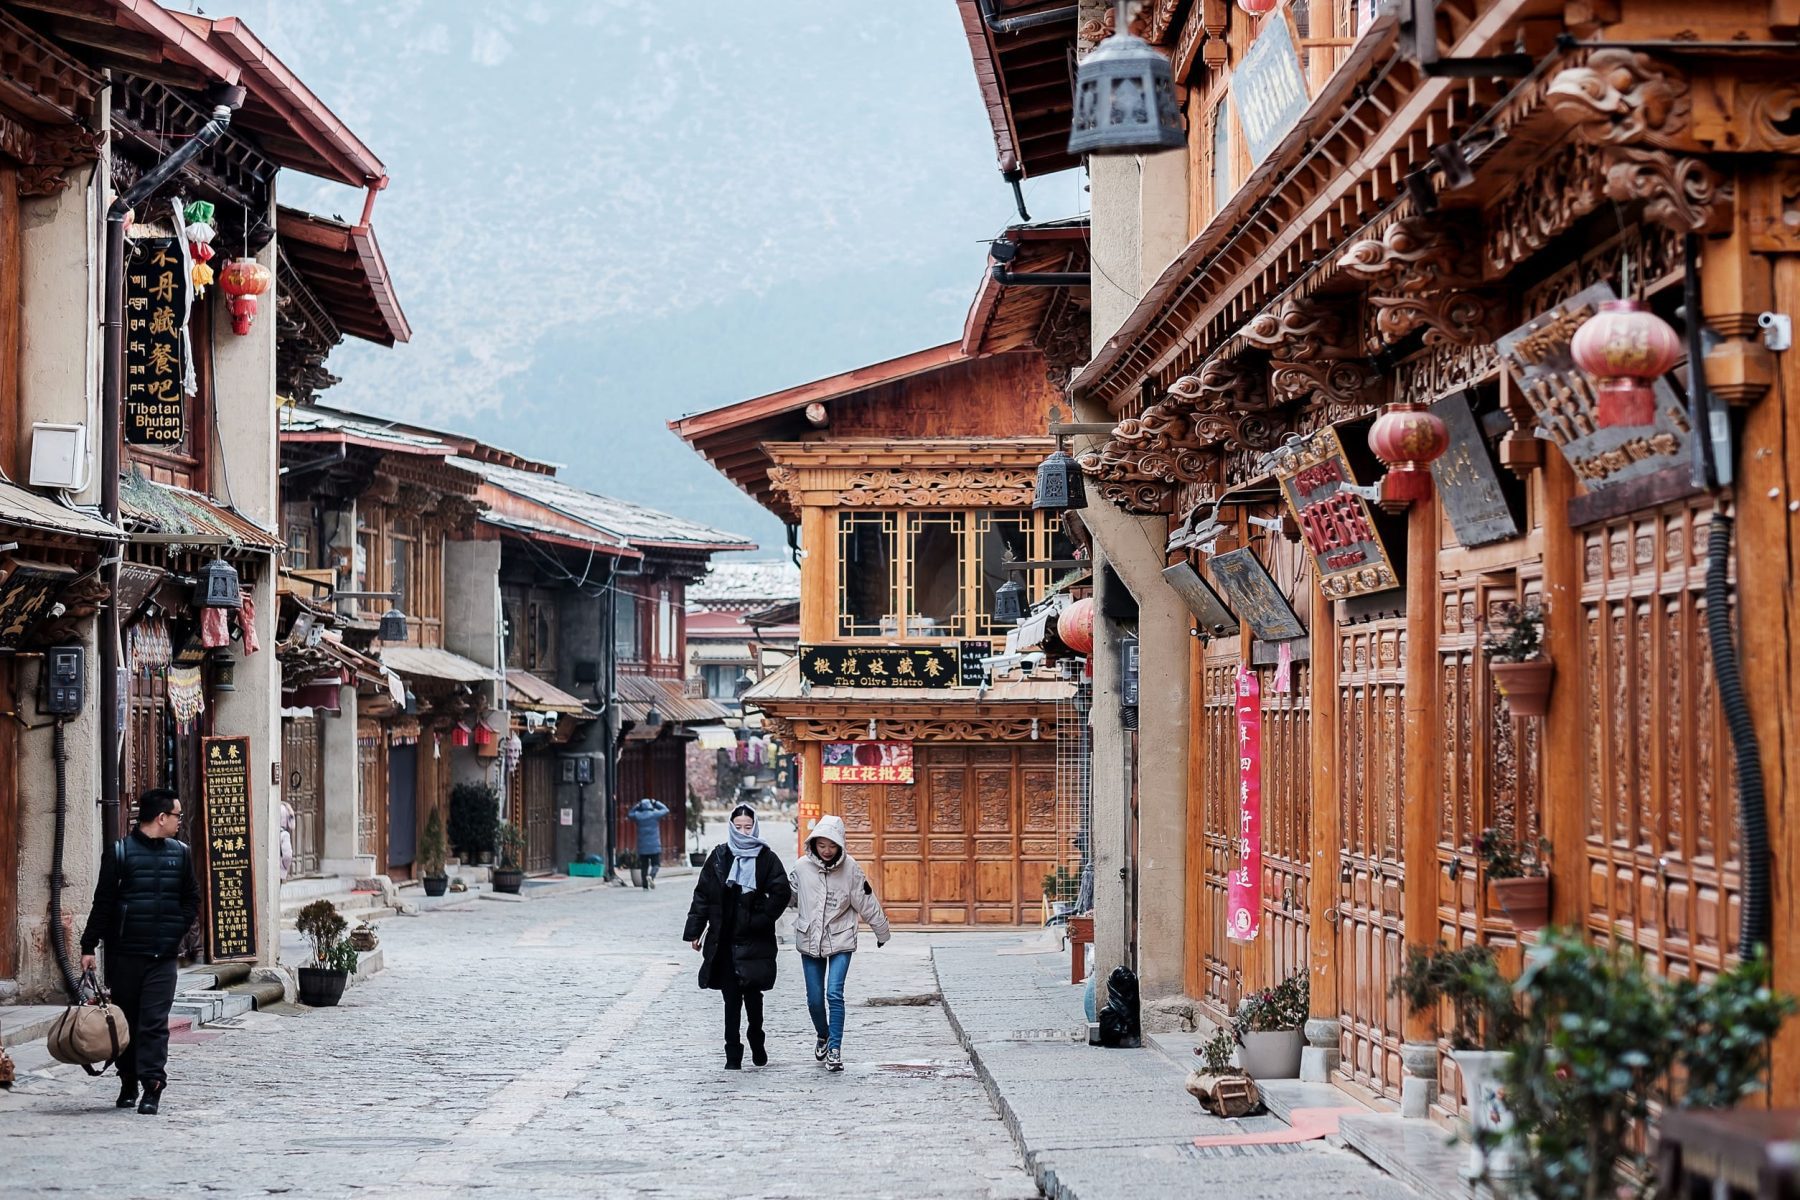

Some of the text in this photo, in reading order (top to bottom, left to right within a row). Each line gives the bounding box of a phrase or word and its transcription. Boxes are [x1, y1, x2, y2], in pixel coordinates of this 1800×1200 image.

[148, 250, 180, 402] 不丹藏餐吧
[128, 403, 180, 414] Tibetan
[136, 415, 180, 426] Bhutan
[146, 428, 180, 440] Food
[813, 656, 944, 678] 橄榄枝藏餐
[835, 677, 924, 686] The Olive Bistro
[822, 766, 914, 783] 藏红花批发
[1235, 705, 1253, 888] 一年四季行好运
